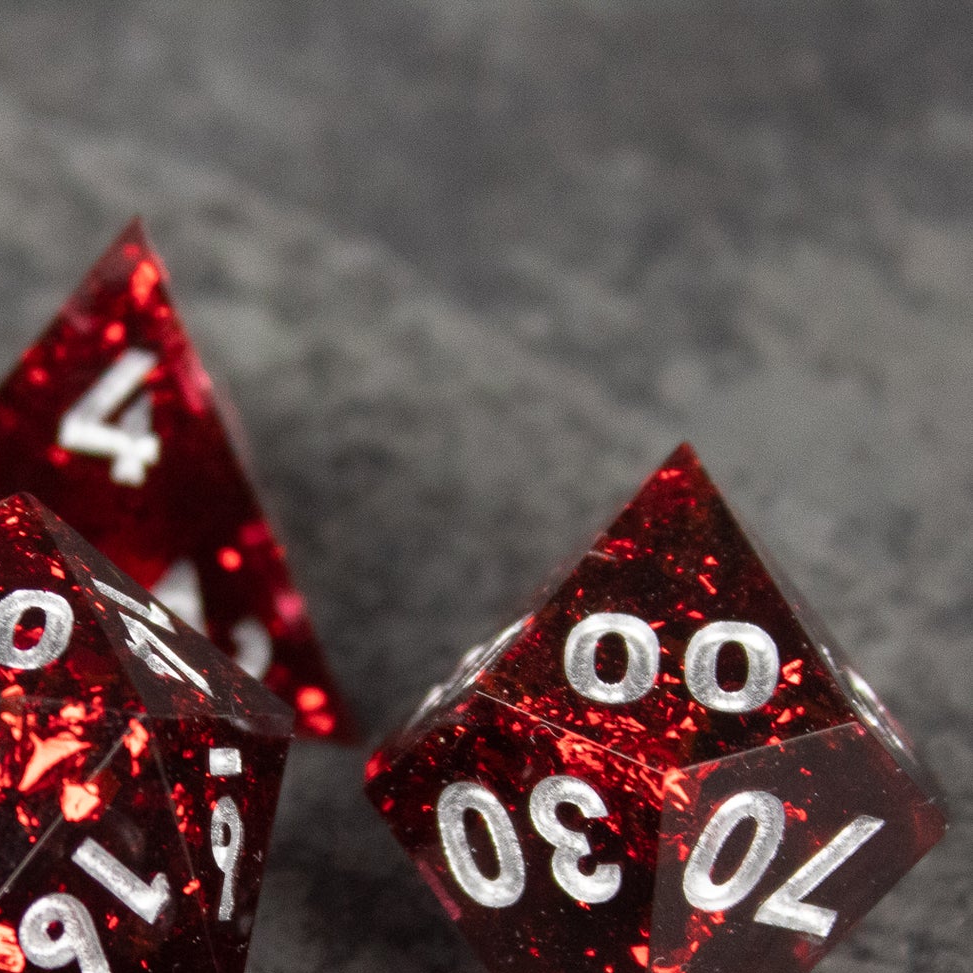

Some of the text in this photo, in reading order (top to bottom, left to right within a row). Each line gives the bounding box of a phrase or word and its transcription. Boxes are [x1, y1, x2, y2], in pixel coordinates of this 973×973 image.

[57, 347, 161, 488] 4
[564, 612, 780, 713] 00
[436, 775, 622, 908] 30
[682, 790, 885, 939] 70
